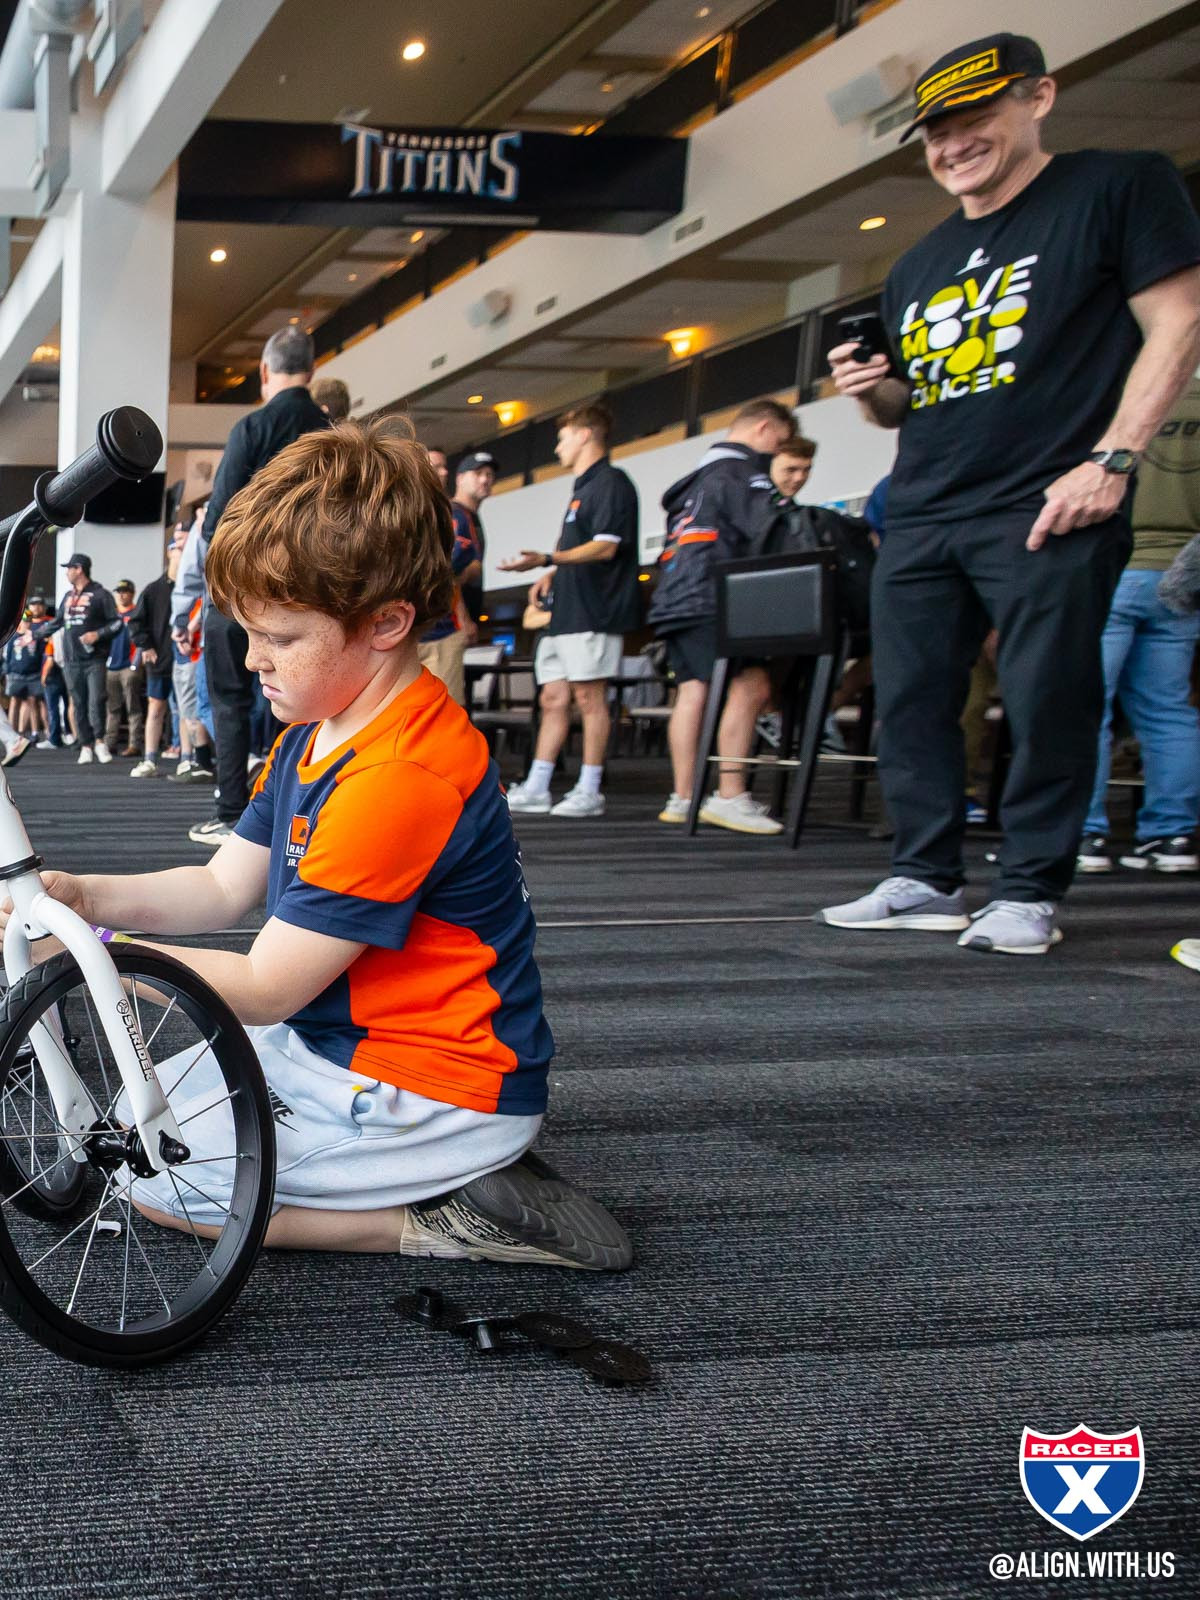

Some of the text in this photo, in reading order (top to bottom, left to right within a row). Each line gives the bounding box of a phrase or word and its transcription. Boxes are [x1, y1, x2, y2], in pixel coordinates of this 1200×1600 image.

[341, 122, 522, 200] TITANS
[900, 253, 1039, 336] LOVE
[122, 1014, 155, 1082] STRIDER
